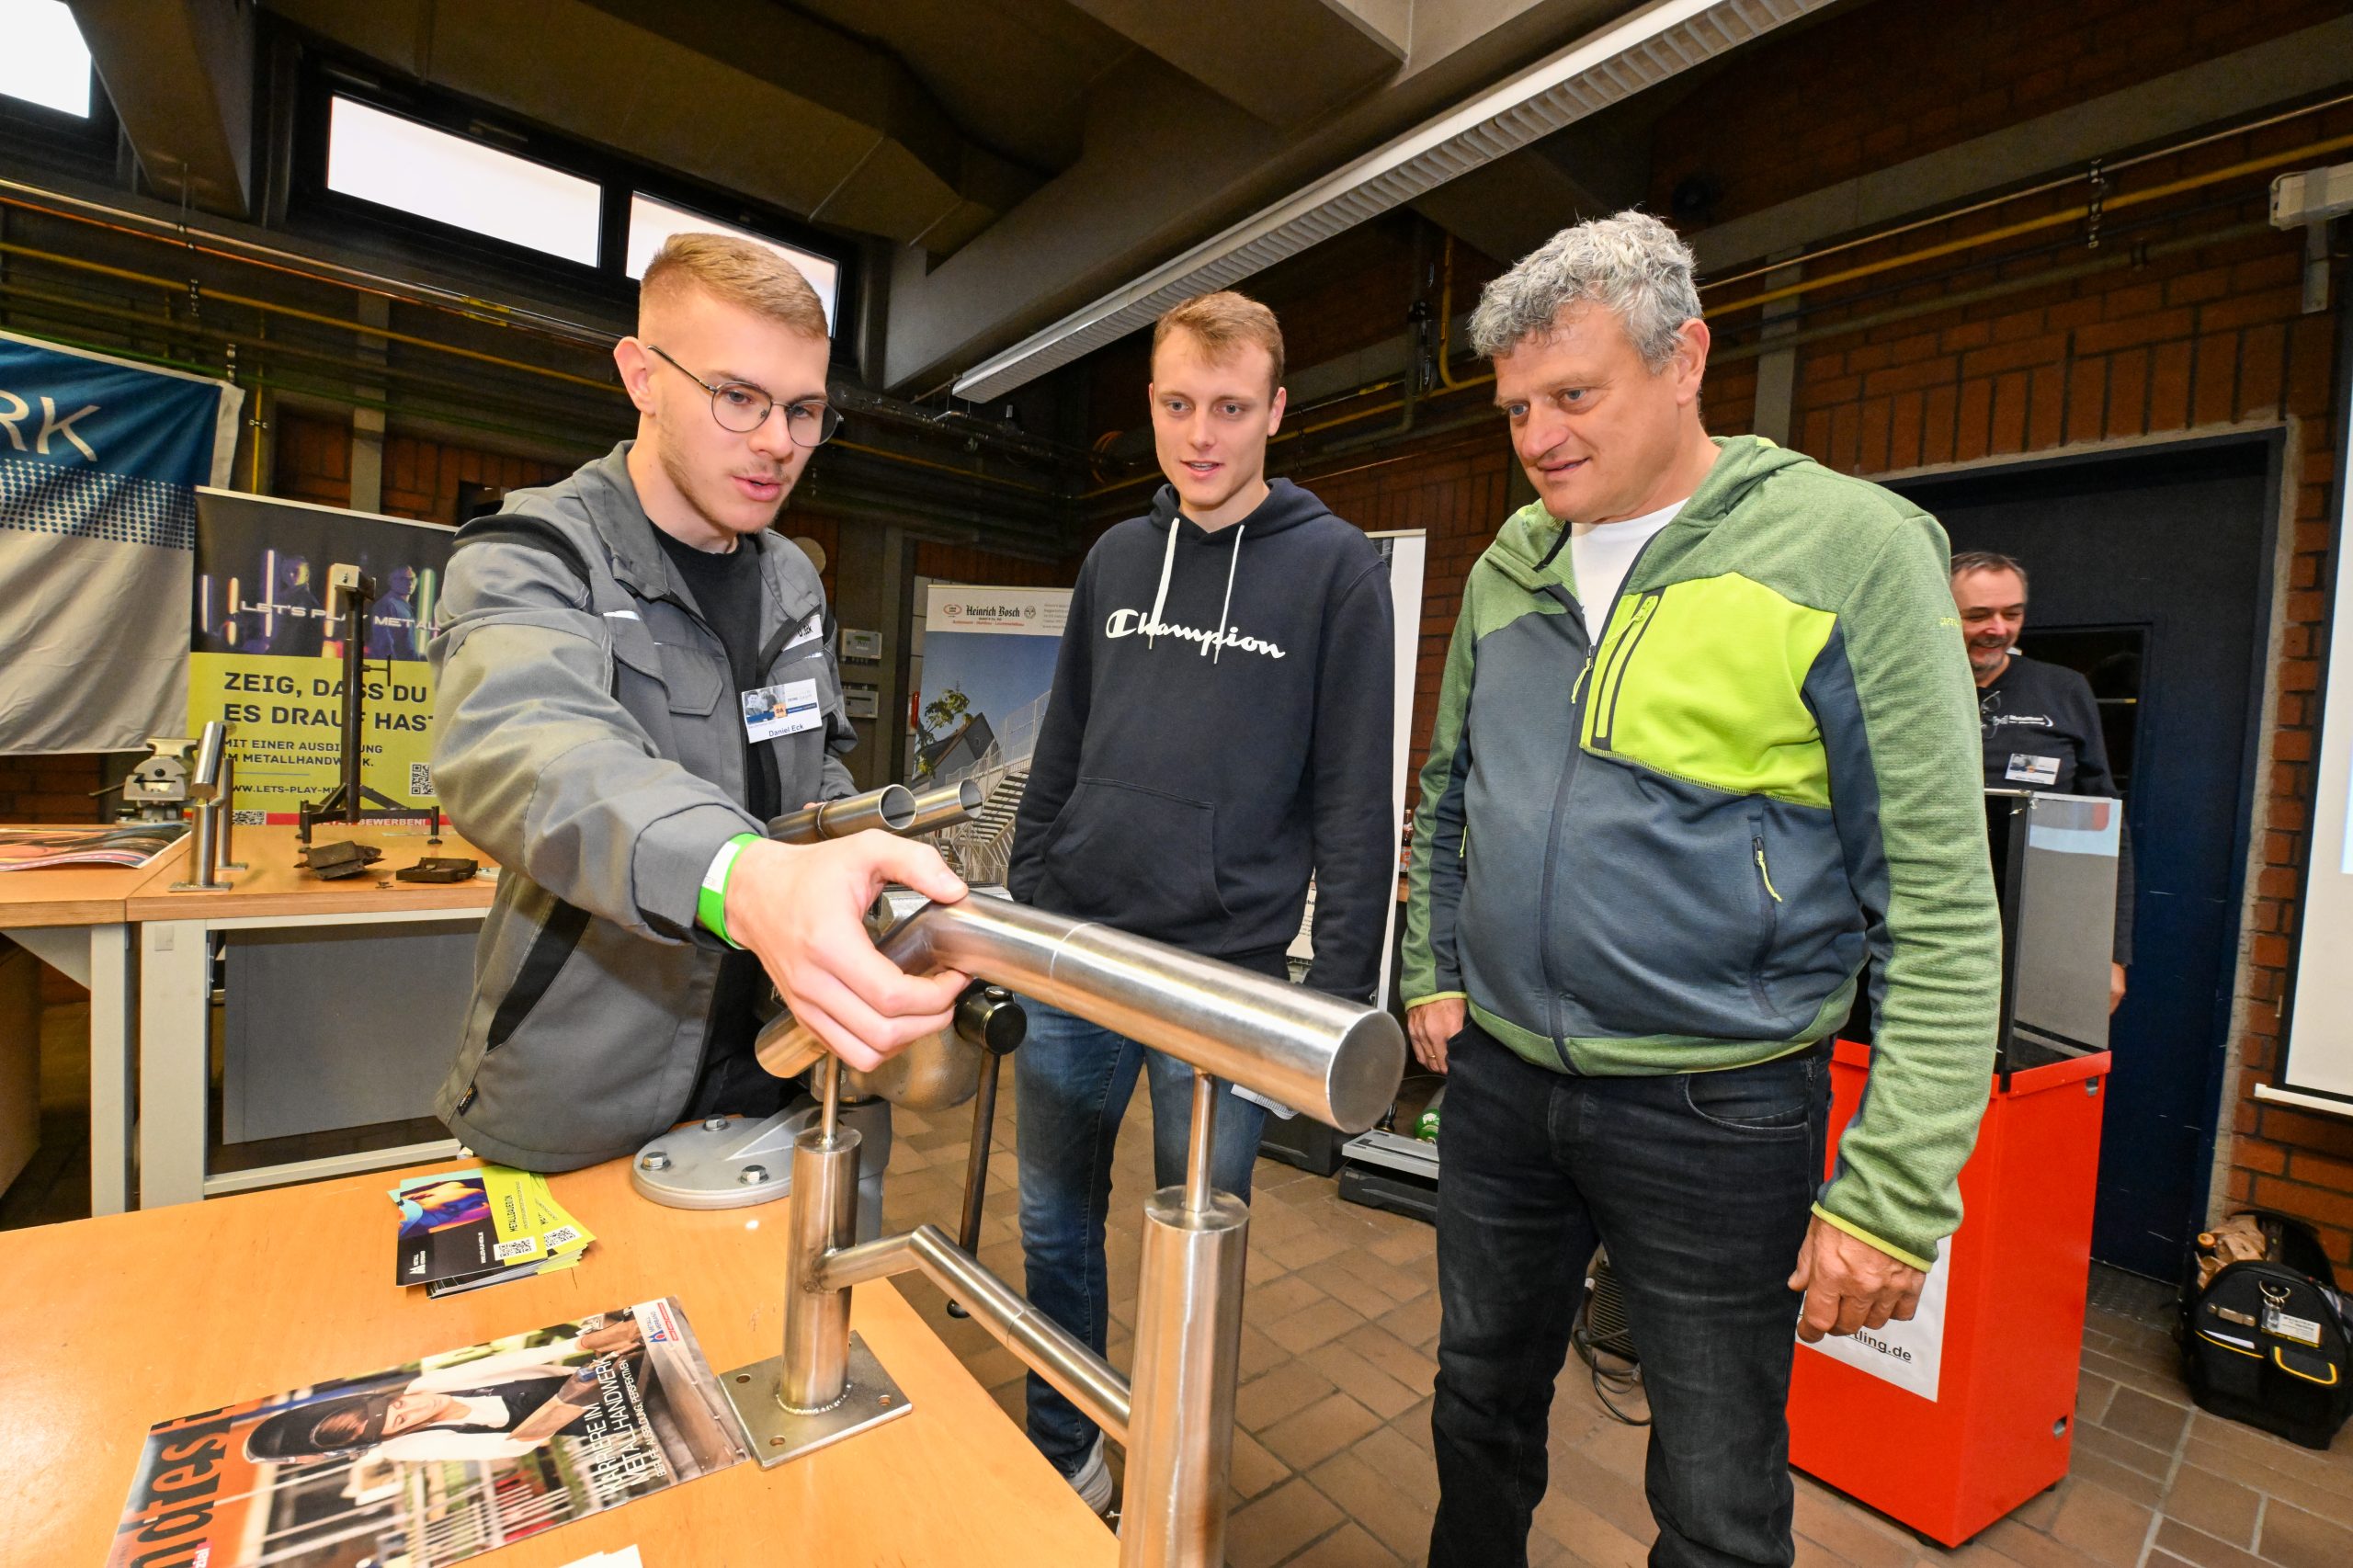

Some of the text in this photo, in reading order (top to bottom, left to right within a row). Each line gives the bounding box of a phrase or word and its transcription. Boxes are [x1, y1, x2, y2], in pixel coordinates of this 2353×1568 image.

[241, 601, 306, 617] LET'S
[374, 616, 440, 631] METAL
[966, 605, 996, 617] Heinrich
[998, 606, 1020, 618] Bosch
[1106, 608, 1286, 658] Champion
[224, 672, 301, 698] ZEIG,
[392, 685, 427, 702] DU
[224, 703, 261, 722] ES
[768, 723, 804, 737] Daniel Eck
[243, 754, 374, 767] METALLHANDWK.
[252, 740, 294, 750] EINER
[300, 742, 383, 754] AUSBIUNG
[1849, 1330, 1912, 1360] tling.de
[619, 1359, 641, 1403] PERSPEKTIVEN
[593, 1359, 650, 1485] METALLHANDWERK
[583, 1403, 623, 1492] KARRIERE IM
